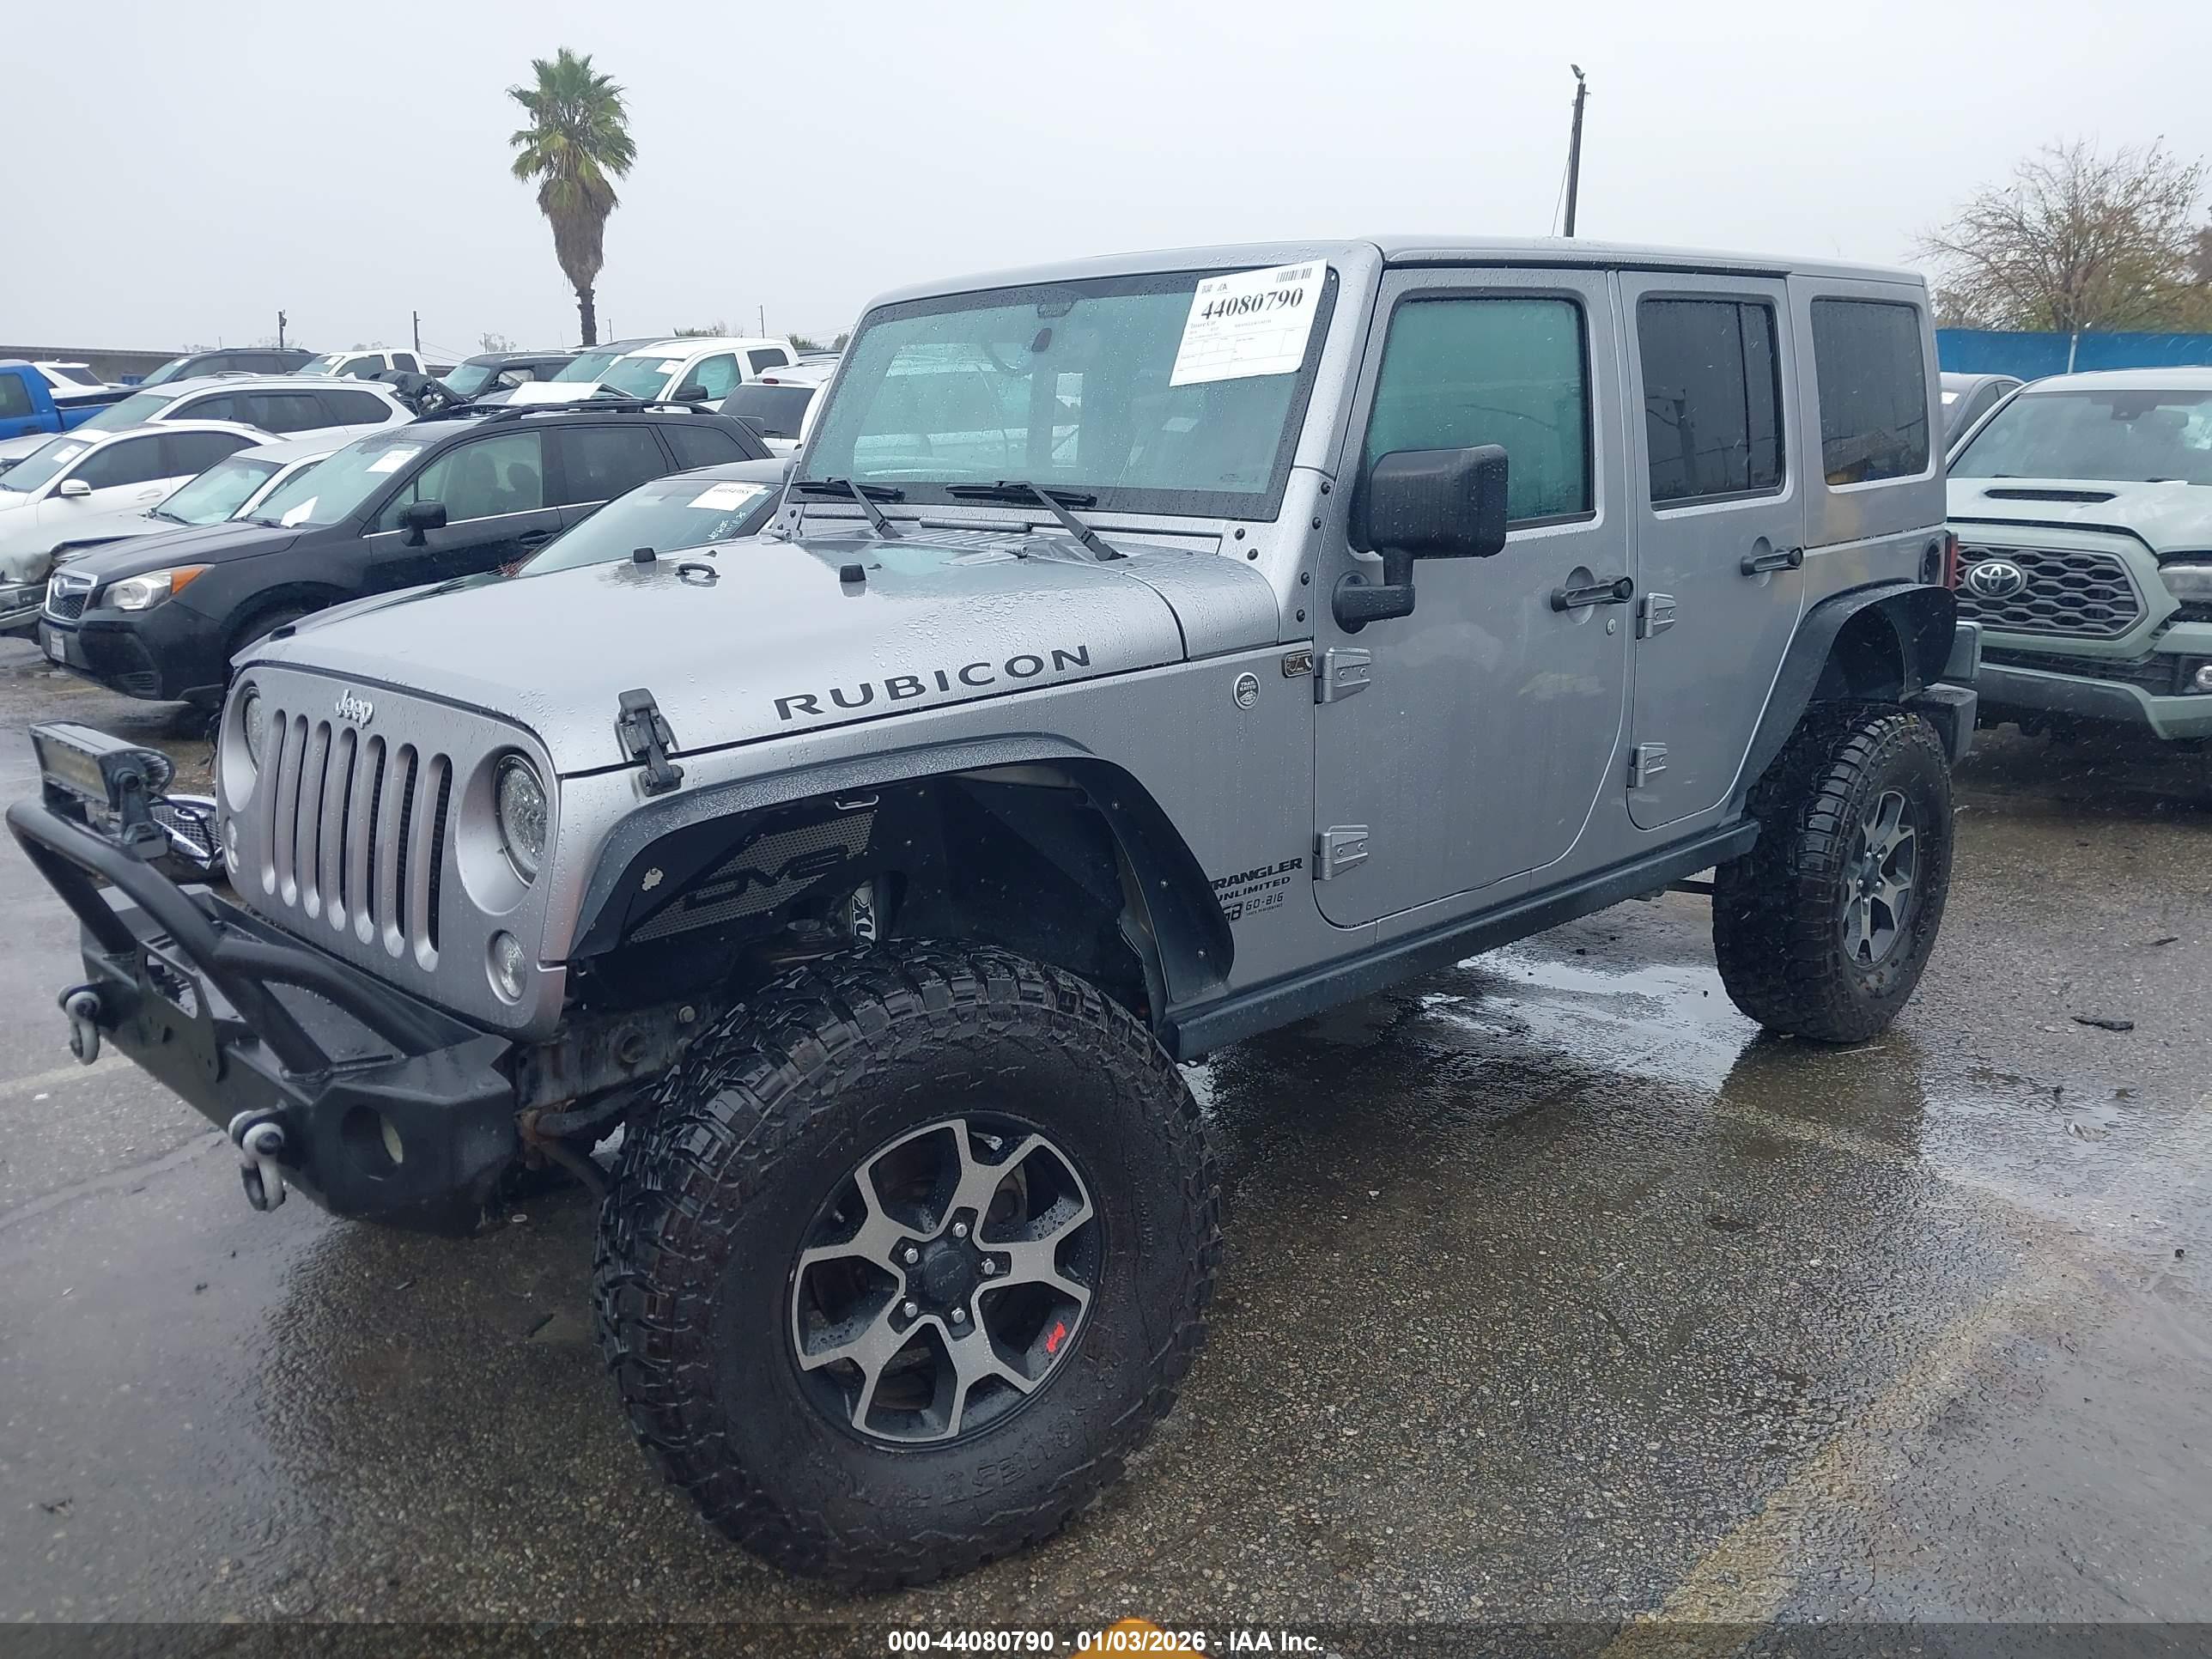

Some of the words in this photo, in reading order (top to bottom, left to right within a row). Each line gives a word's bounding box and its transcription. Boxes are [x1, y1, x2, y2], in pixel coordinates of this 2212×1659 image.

[1201, 288, 1304, 319] 44080790
[774, 646, 1091, 720] RUBICON
[336, 689, 374, 729] Jeep
[1211, 858, 1303, 890] RANGLER
[851, 894, 875, 941] OX
[1245, 891, 1285, 910] GO-BIG
